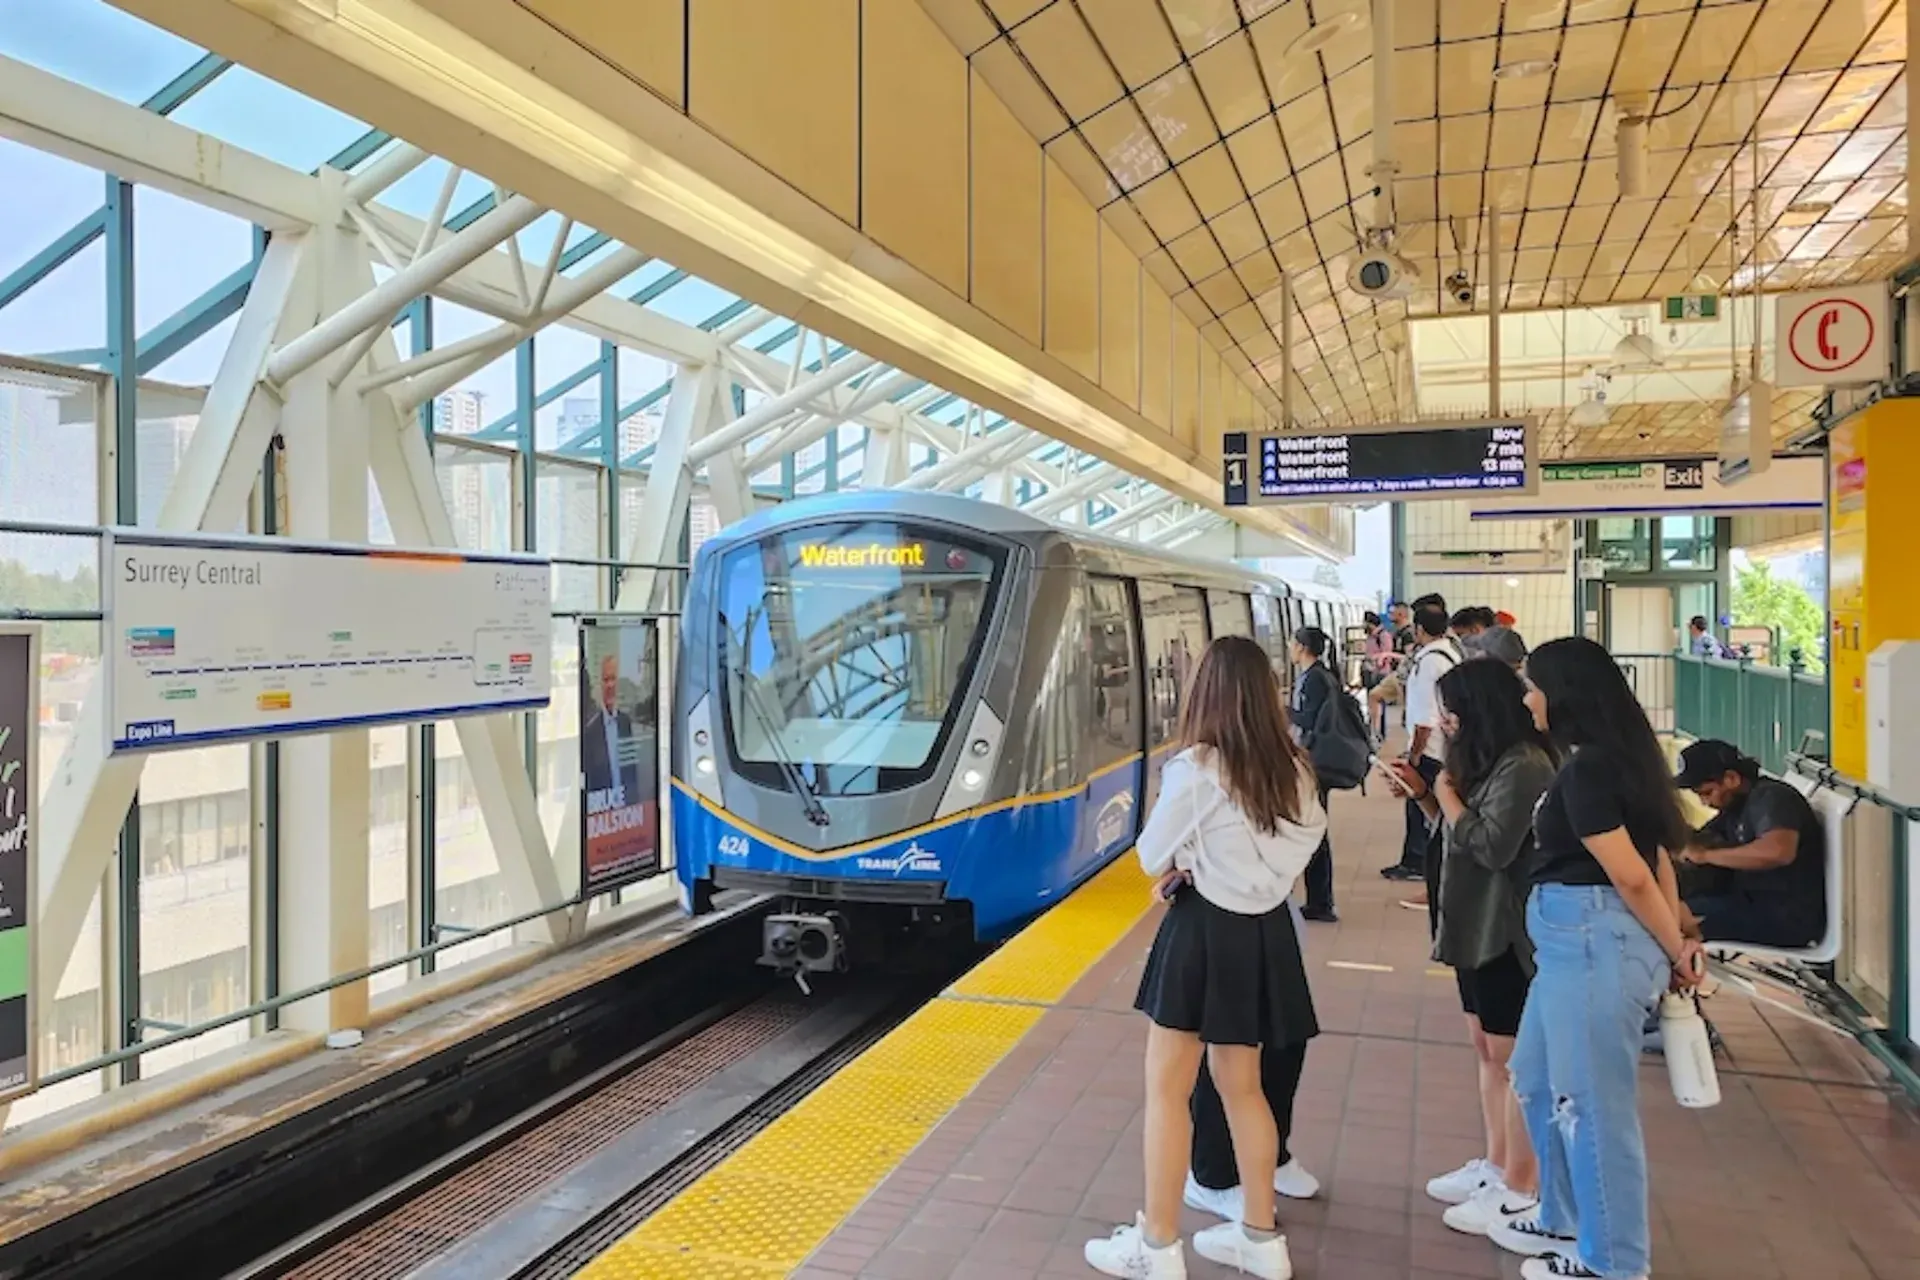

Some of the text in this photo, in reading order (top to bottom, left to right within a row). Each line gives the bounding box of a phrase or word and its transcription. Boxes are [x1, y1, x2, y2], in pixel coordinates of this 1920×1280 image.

[1277, 428, 1524, 452] Waterfront Now
[1277, 442, 1524, 467] Waterfront 7 min
[1228, 460, 1244, 486] 1
[1277, 457, 1524, 482] Waterfront 13 min
[1665, 467, 1702, 486] Exit
[800, 543, 925, 567] Waterfront
[124, 557, 261, 589] Surrey Central
[127, 722, 174, 741] Expo Line
[586, 785, 627, 815] BRUCE
[586, 803, 645, 839] RALSTON
[717, 835, 750, 858] 424
